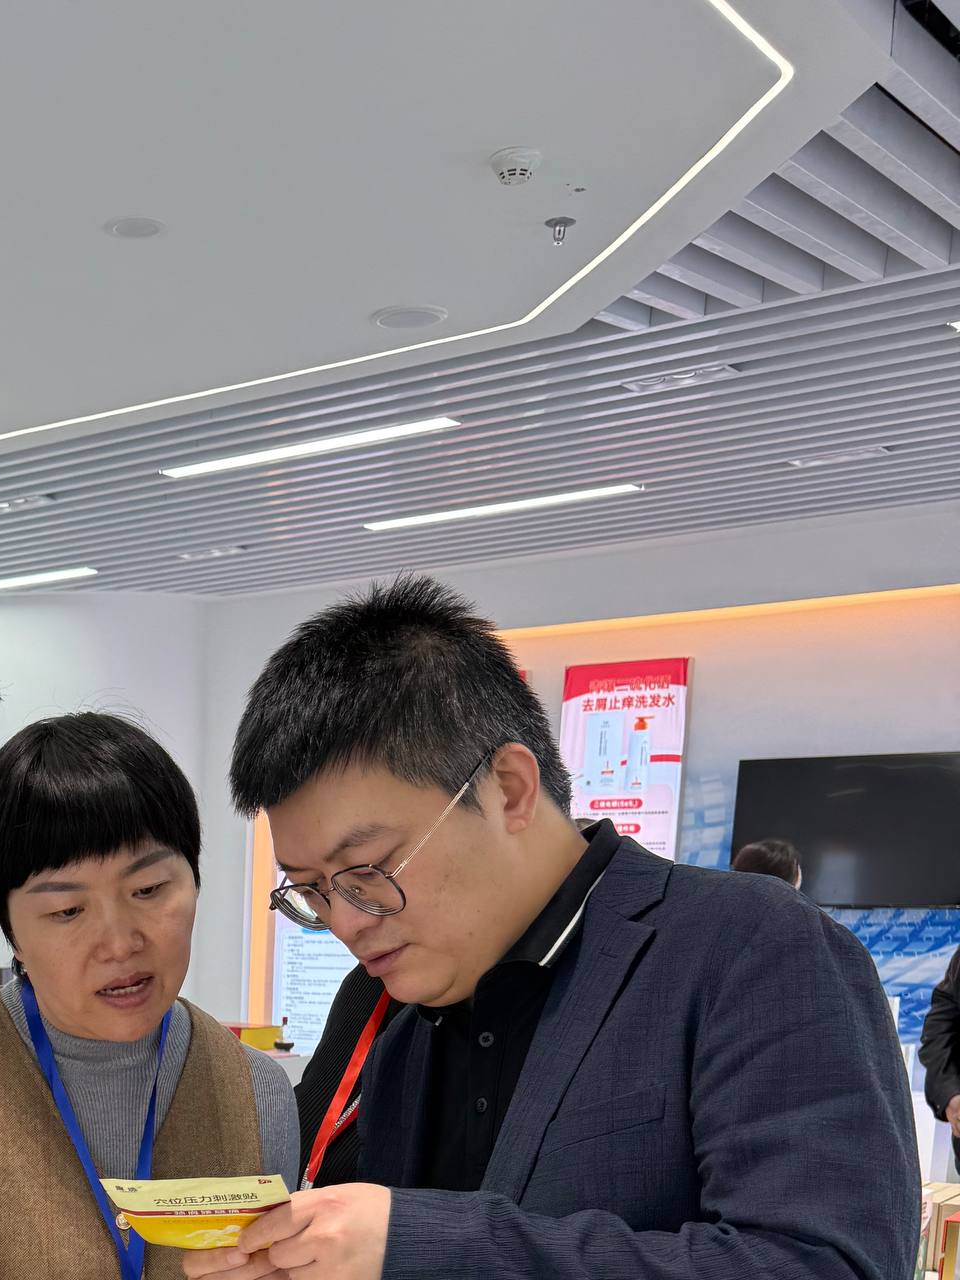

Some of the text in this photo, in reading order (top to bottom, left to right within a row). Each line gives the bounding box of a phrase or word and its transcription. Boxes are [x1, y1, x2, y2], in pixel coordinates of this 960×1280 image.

[582, 692, 676, 712] 去屑止痒洗发水
[154, 1192, 259, 1205] 穴位压力刺激贴
